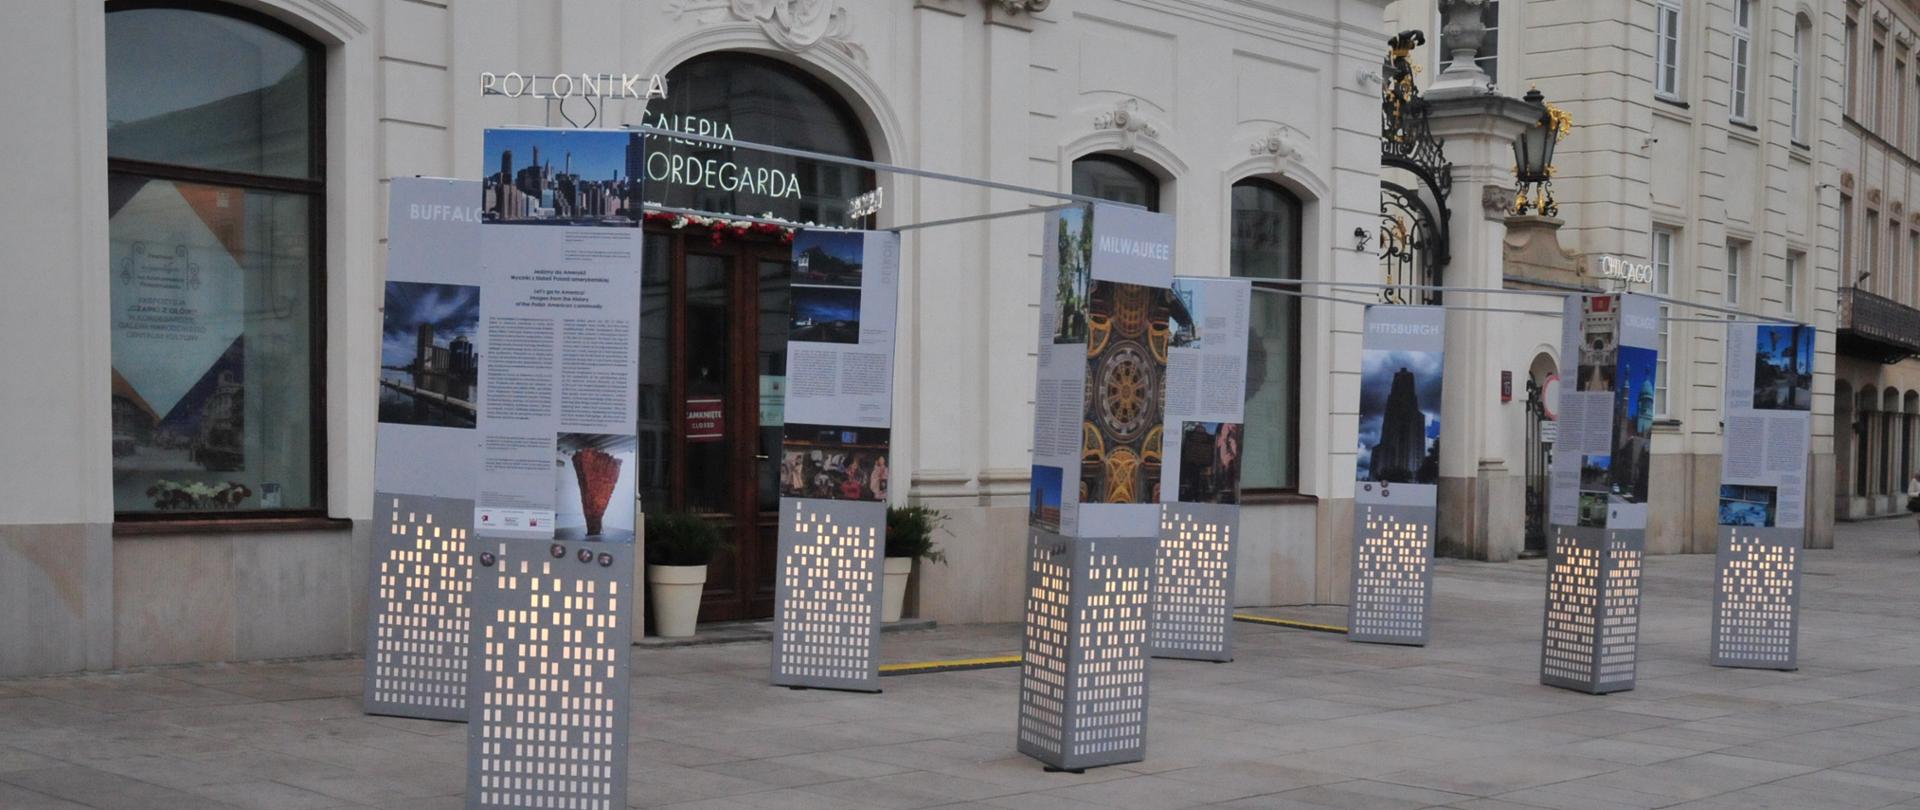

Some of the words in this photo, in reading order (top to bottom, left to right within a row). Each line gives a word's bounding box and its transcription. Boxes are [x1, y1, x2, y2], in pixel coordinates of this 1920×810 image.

[480, 71, 668, 99] POLONIKA
[647, 151, 802, 200] ORDEGARDA
[1100, 234, 1169, 260] MILWAUKEE
[1602, 255, 1653, 284] CHICAGO
[1368, 322, 1440, 336] PITTSBURGH
